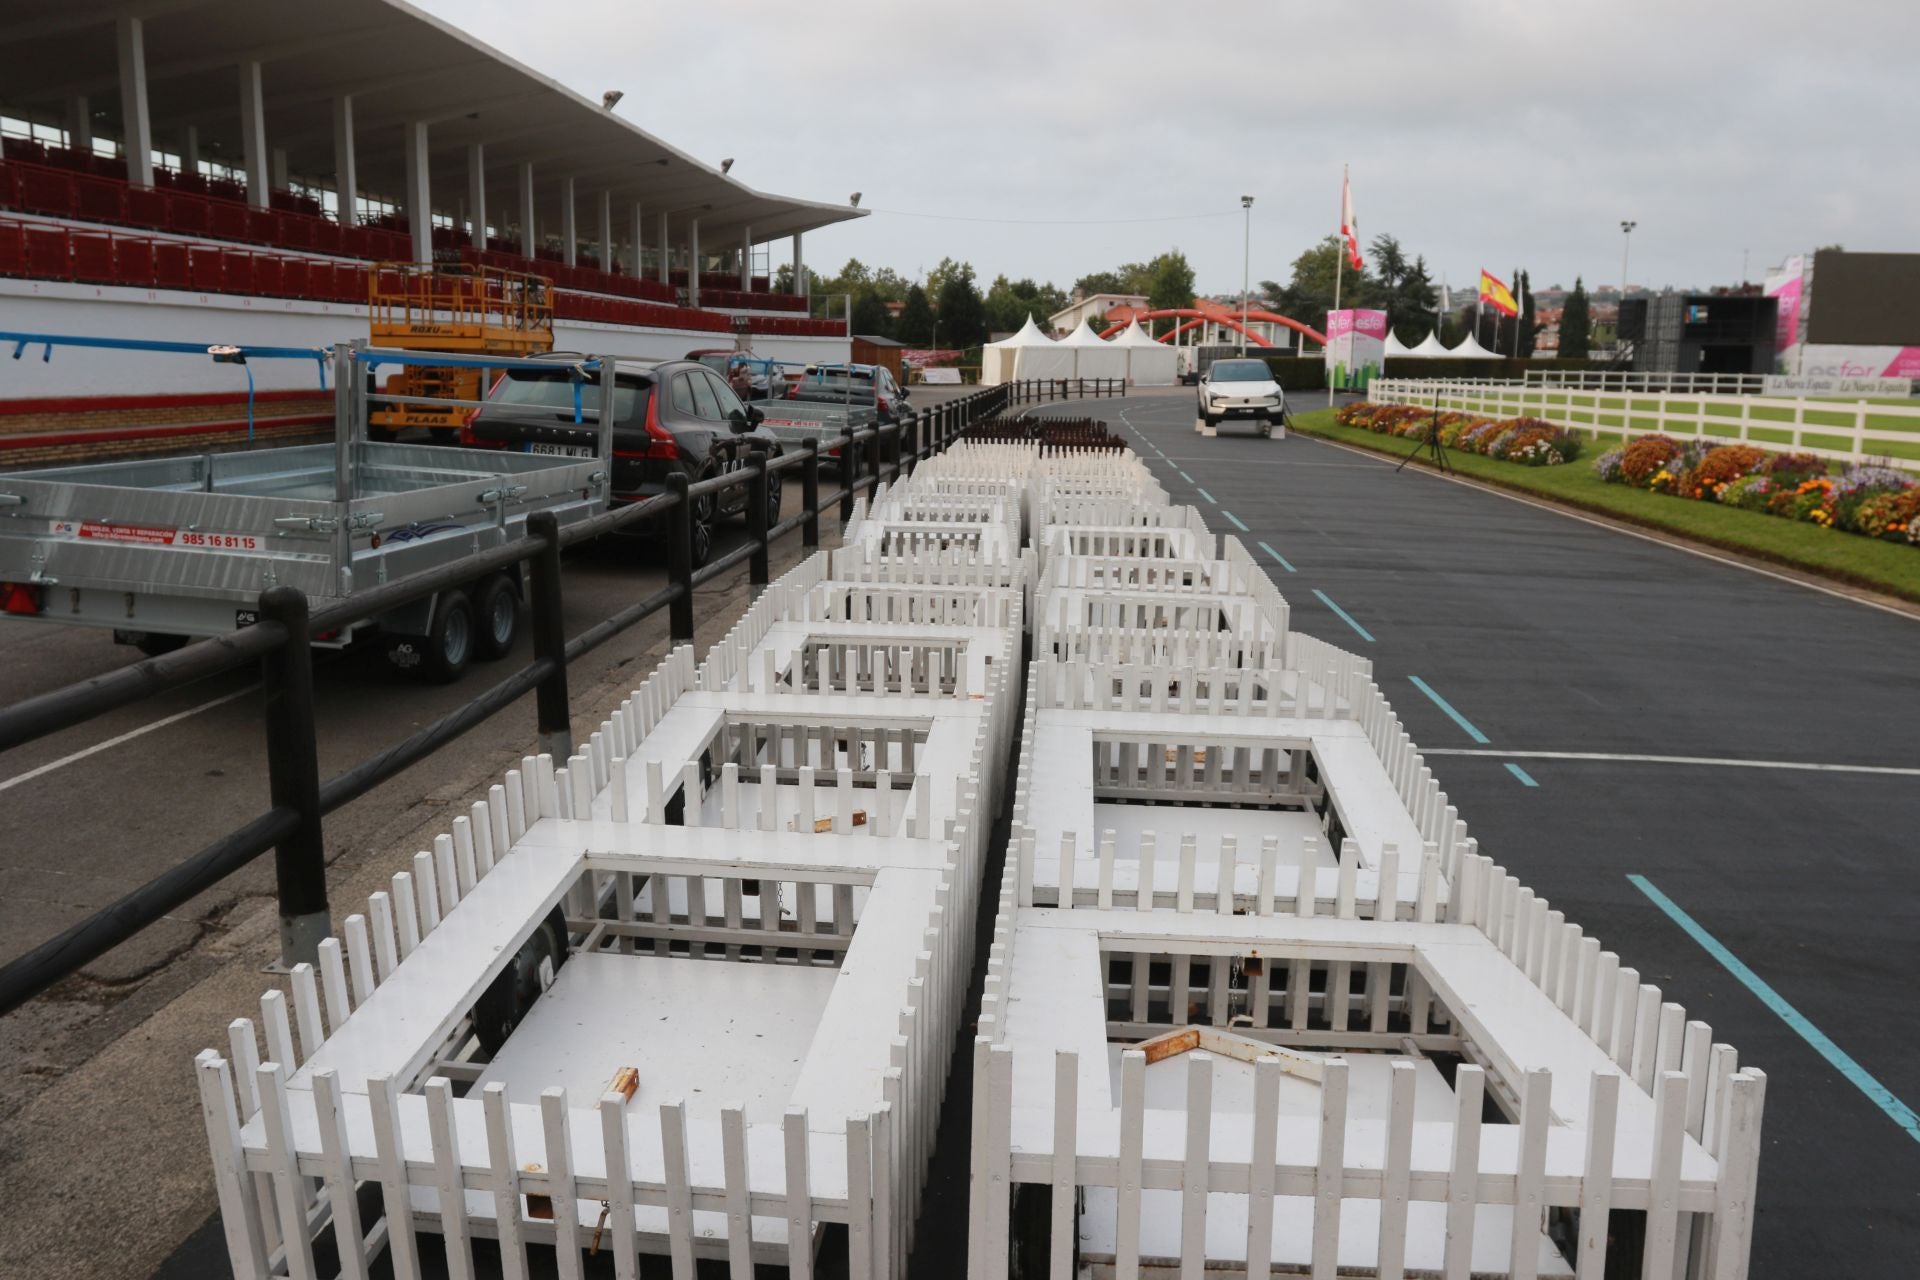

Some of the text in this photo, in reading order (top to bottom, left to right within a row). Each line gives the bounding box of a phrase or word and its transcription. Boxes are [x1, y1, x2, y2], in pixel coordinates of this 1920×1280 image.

[1329, 315, 1352, 329] efer
[410, 325, 440, 334] ROXU
[406, 415, 448, 424] PLAAS
[533, 444, 561, 456] 6681
[182, 534, 256, 549] 985 16 81 15
[397, 643, 413, 654] AG
